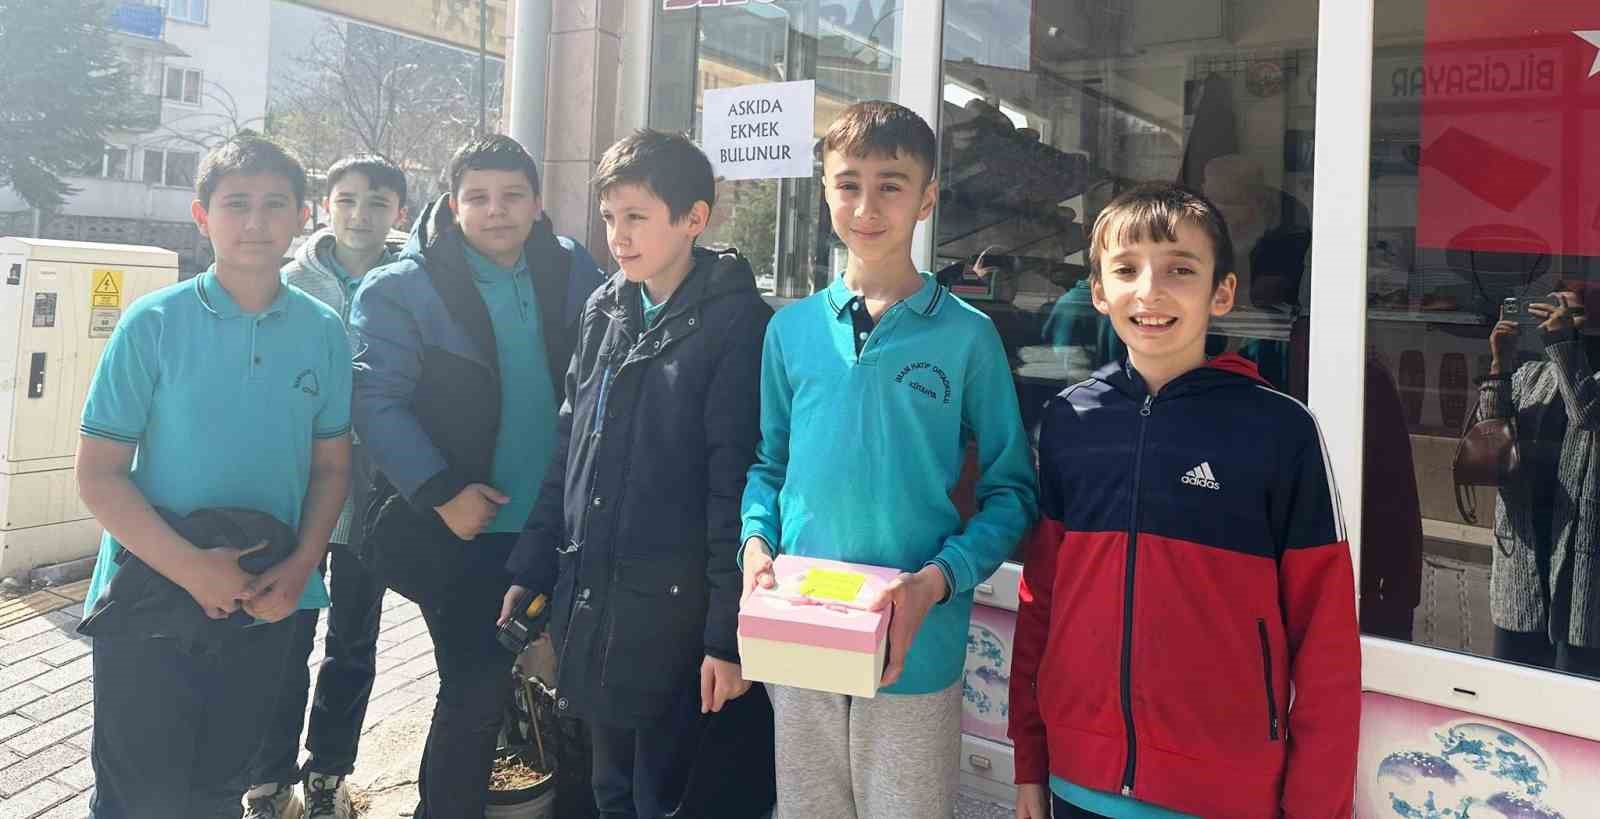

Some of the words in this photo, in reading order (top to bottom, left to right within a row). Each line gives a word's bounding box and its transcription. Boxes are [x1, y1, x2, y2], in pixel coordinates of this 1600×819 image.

[727, 99, 783, 117] ASKIDA
[730, 121, 780, 139] EKMEK
[719, 144, 792, 163] BULUNUR
[1181, 475, 1220, 490] adidas
